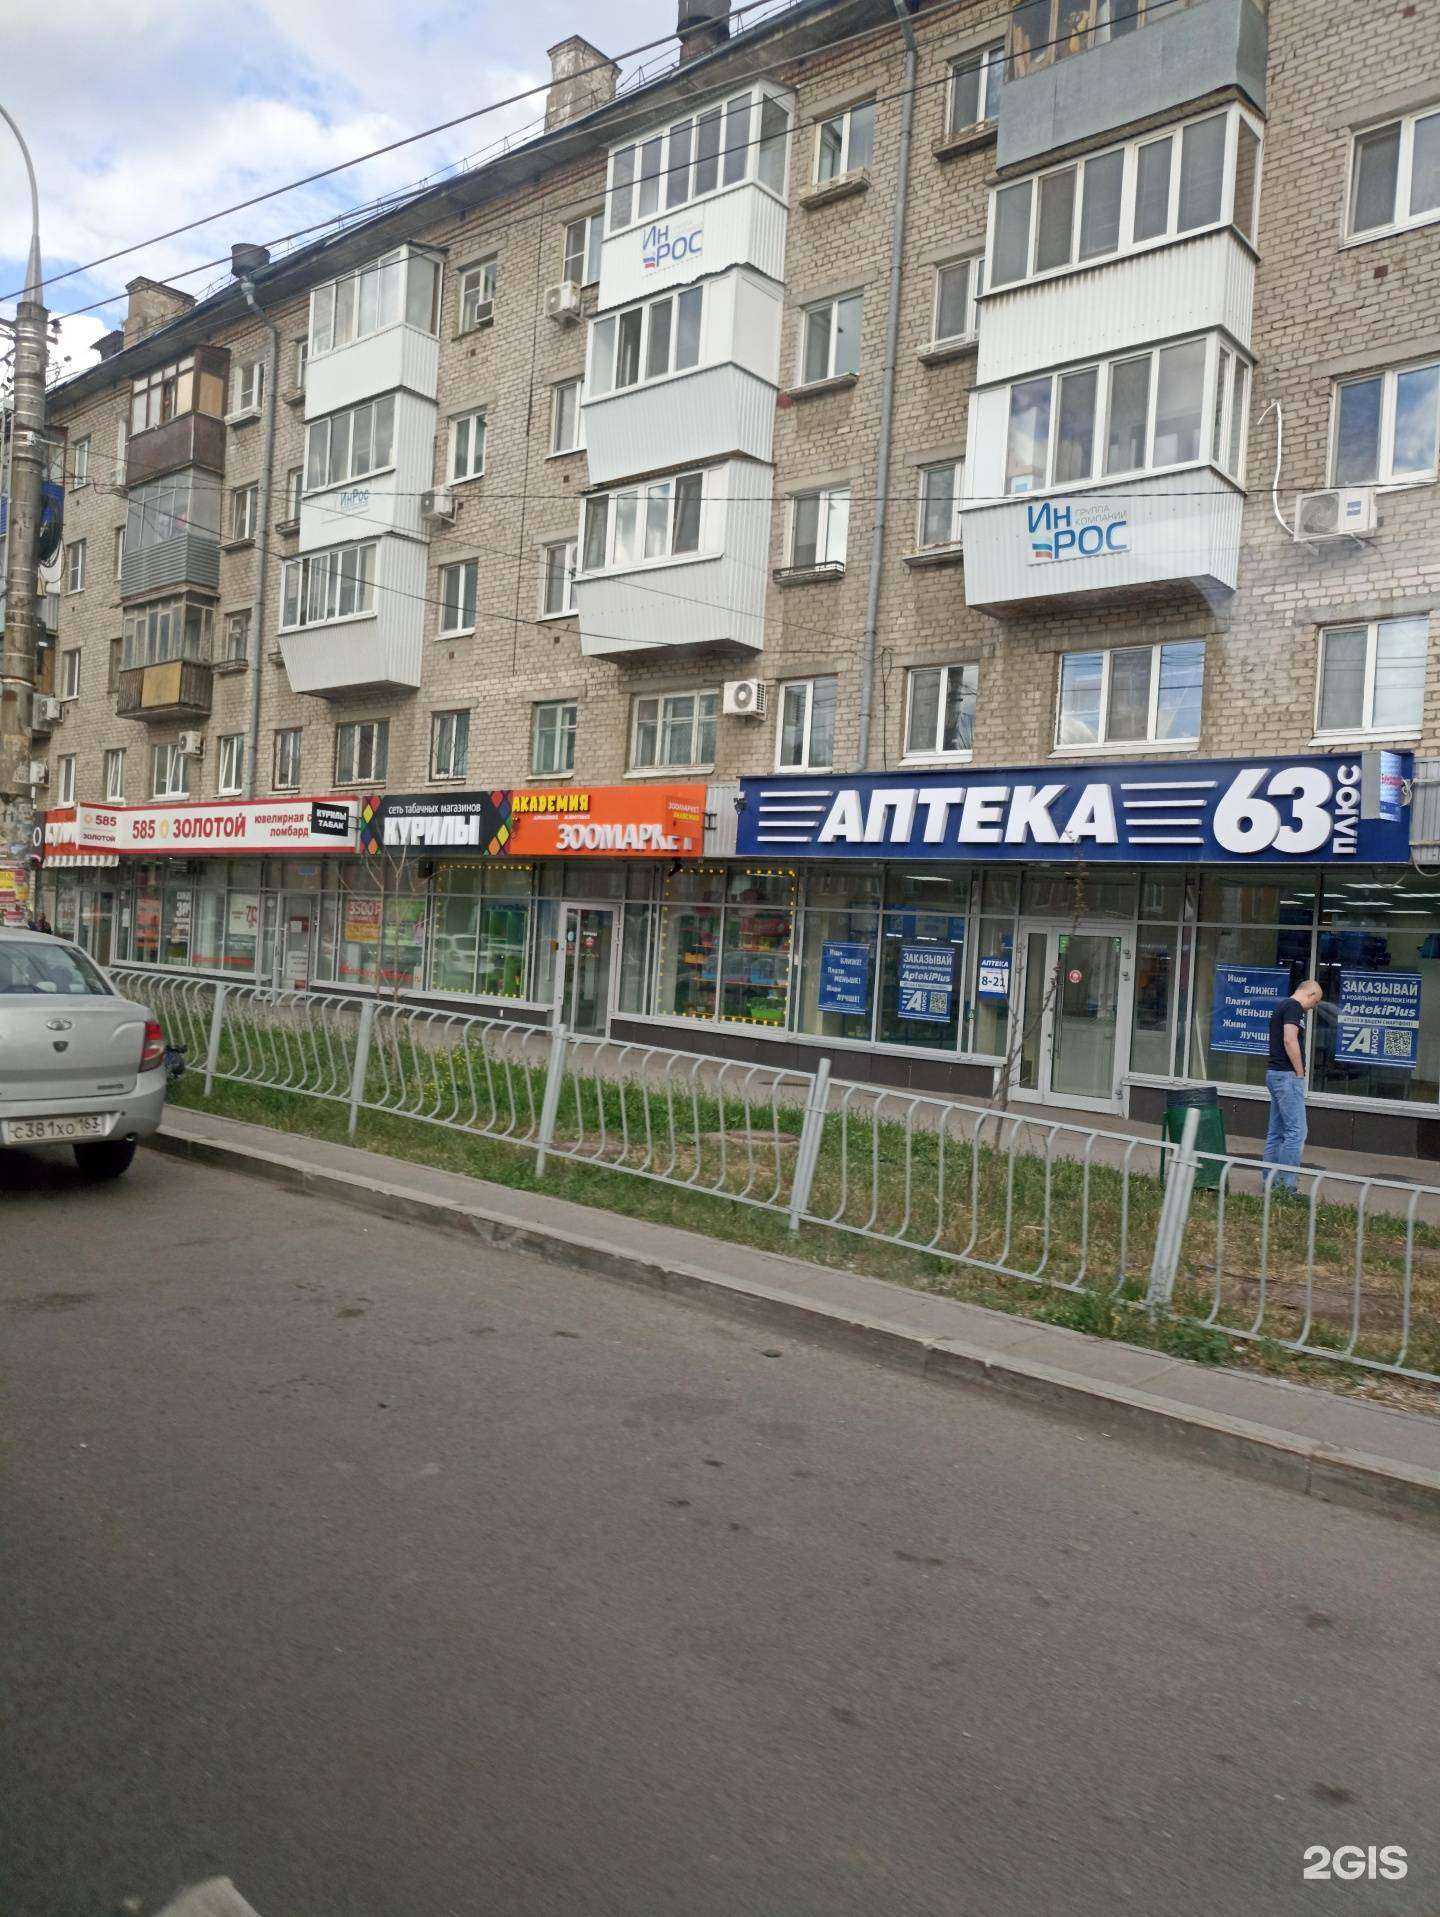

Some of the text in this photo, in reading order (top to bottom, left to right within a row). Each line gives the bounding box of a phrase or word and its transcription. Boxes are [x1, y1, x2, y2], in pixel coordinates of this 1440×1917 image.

[656, 229, 703, 267] РОС
[1055, 520, 1127, 559] РОС
[388, 802, 481, 815] сеть табачных магазинов
[512, 794, 590, 813] АКАДЕМИЯ
[1213, 766, 1334, 854] 63
[1333, 764, 1361, 854] ПЛЮС
[254, 813, 304, 826] ювелирная
[817, 783, 1119, 844] АПТЕКА
[95, 815, 118, 827] 585
[132, 812, 246, 839] 585 ЗОЛОТОЙ
[318, 819, 344, 830] ТАБАК
[270, 825, 309, 839] ломбард
[903, 953, 953, 965] ЗАКАЗЫВАЙ
[981, 959, 1009, 968] АПТЕКА
[902, 970, 951, 982] AptekiPlus
[981, 976, 1006, 987] 8-21
[1227, 973, 1247, 983] Ищи
[1244, 985, 1278, 996] БЛИЖЕ!
[1342, 980, 1418, 996] ЗАКАЗЫВАЙ
[1225, 996, 1250, 1006] Плати
[1342, 1002, 1416, 1017] AptekiPlus
[1223, 1019, 1247, 1028] Живи
